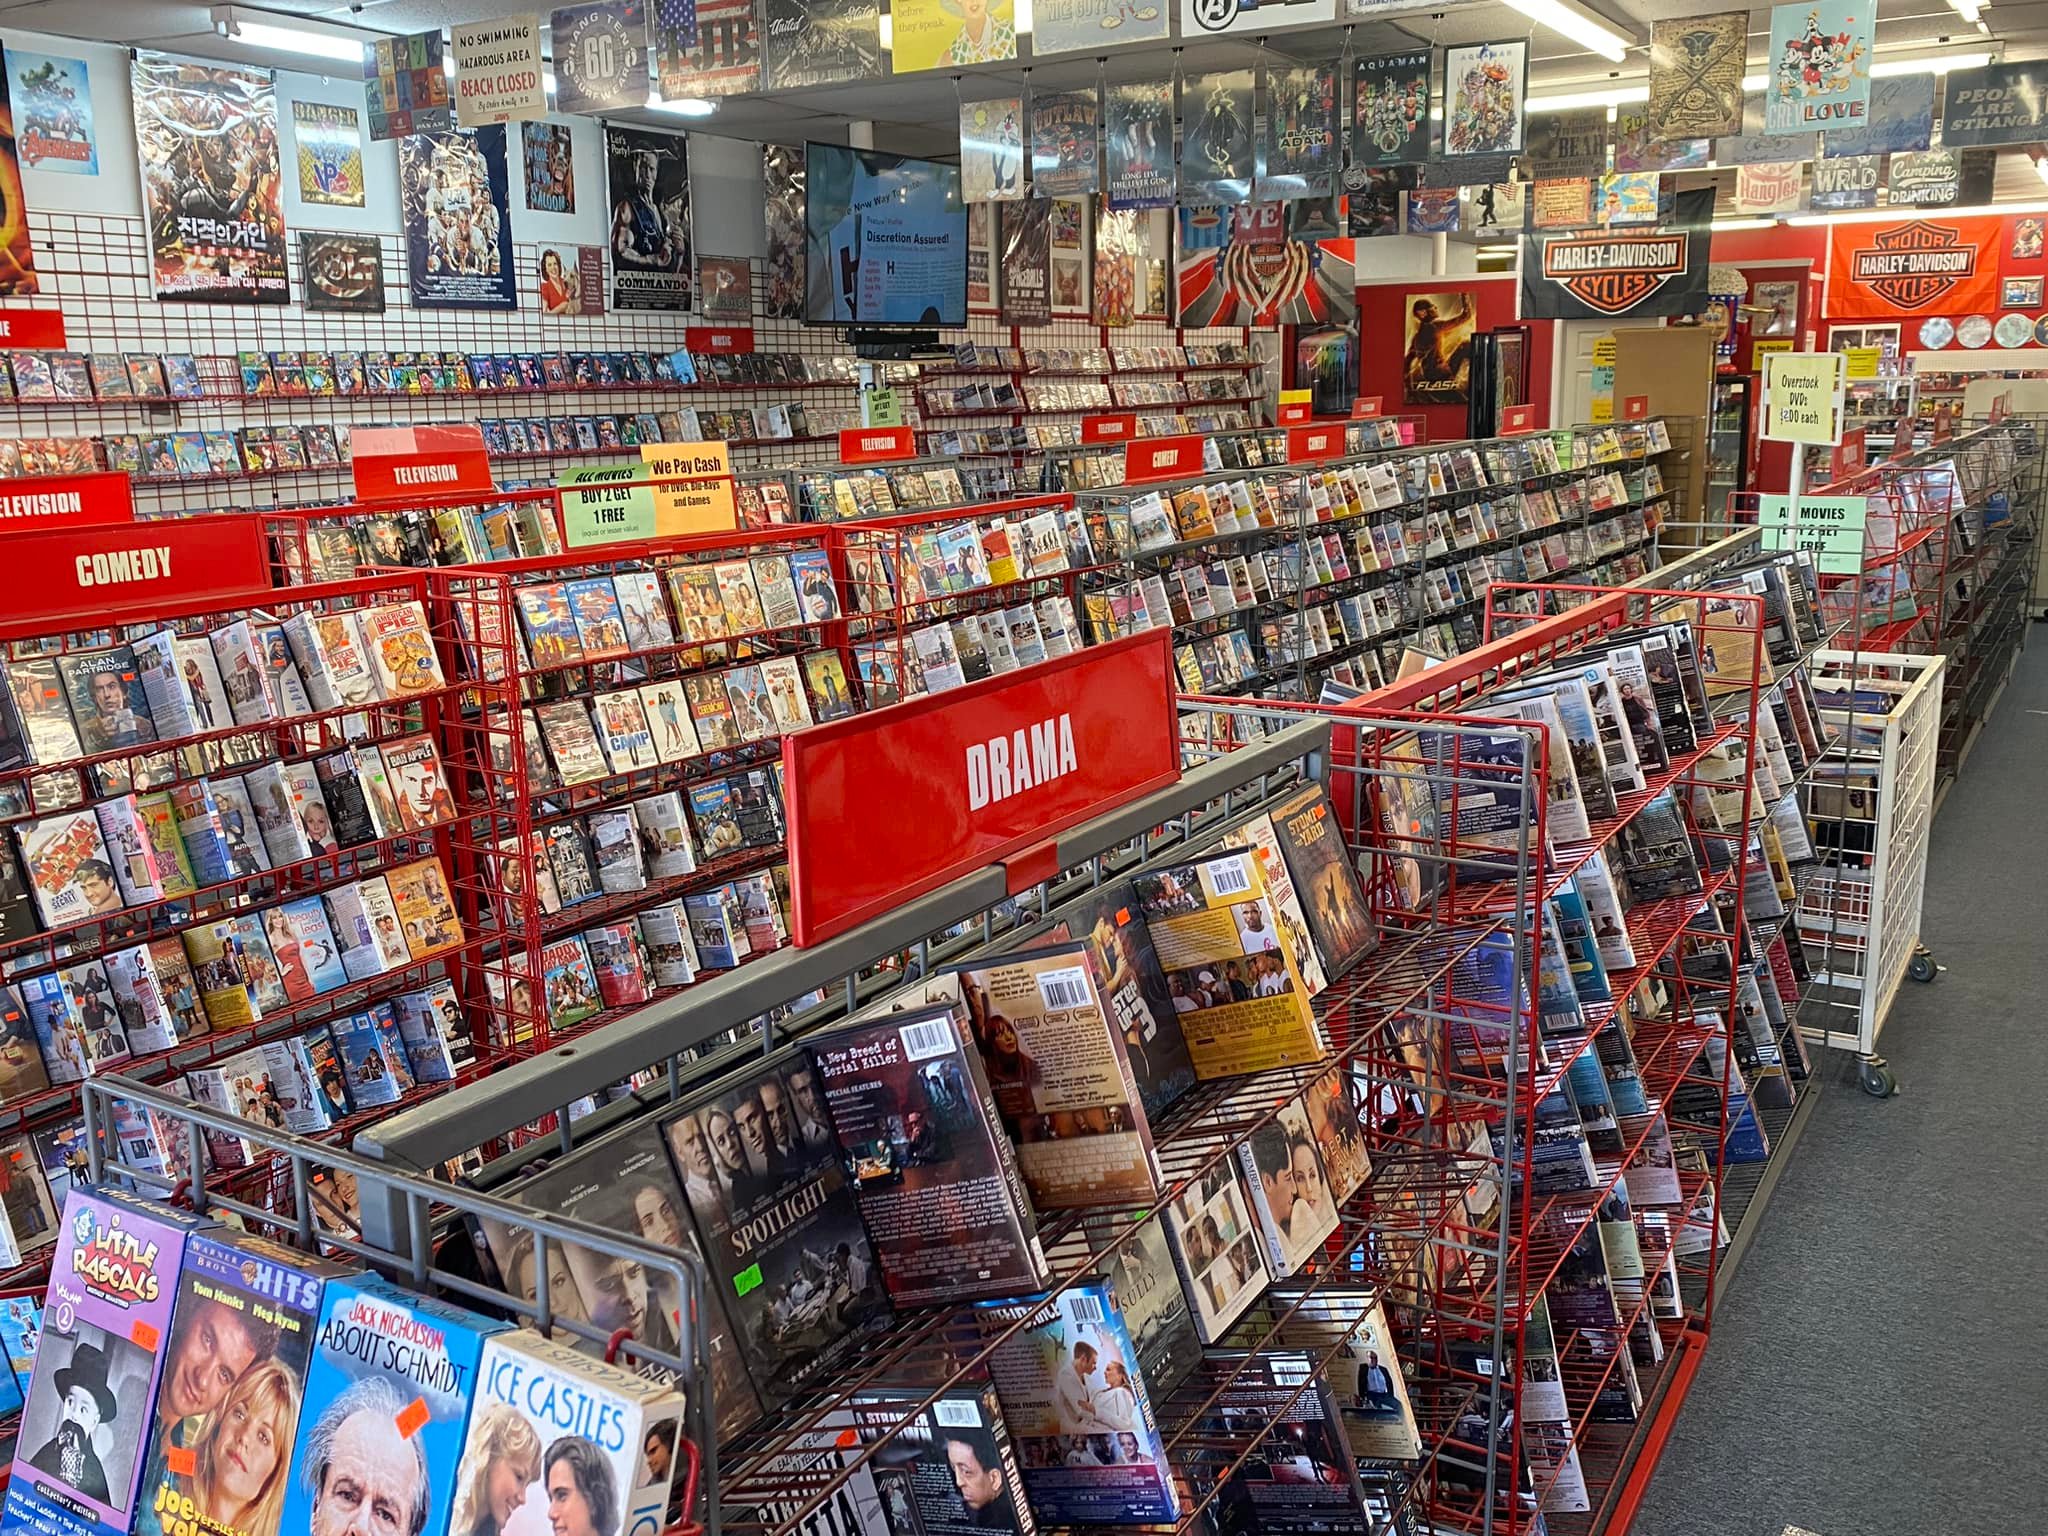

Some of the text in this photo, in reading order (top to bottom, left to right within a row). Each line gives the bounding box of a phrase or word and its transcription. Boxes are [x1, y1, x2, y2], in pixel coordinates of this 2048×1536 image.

[568, 12, 630, 55] HANG TEN
[769, 14, 804, 37] United
[898, 21, 918, 33] they
[459, 26, 529, 48] NO SWIMMING
[459, 49, 531, 70] HAZARDOUS AREA
[584, 34, 614, 80] 60
[1358, 55, 1427, 71] AQUAMAN
[461, 72, 536, 97] BEACH CLOSED
[1034, 104, 1097, 130] OUTLAW
[1804, 100, 1865, 122] LOVE
[1971, 103, 2015, 117] ARE
[1280, 135, 1328, 150] ADAM
[1288, 128, 1323, 139] BLACK
[18, 130, 92, 167] AVENGERS
[1121, 170, 1159, 181] LONG LIVE
[1816, 167, 1877, 193] WRLD
[1893, 161, 1957, 181] Camping
[1113, 179, 1126, 188] THE
[1149, 176, 1168, 186] GUN
[874, 193, 890, 204] Way
[1113, 186, 1172, 200] BRANDON
[1890, 187, 1956, 204] DRINKING
[867, 230, 949, 245] Discretion Assured!
[1888, 231, 1945, 249] MOTOR
[1554, 242, 1678, 270] HARLEY-DAVIDSON
[1861, 253, 1968, 275] HARLEY-DAVIDSON
[887, 261, 895, 275] H
[617, 277, 689, 290] COMMANDO
[1581, 274, 1646, 302] CYCLES
[1884, 279, 1941, 301] CYCLES
[1416, 380, 1461, 391] FLASH
[1782, 375, 1819, 389] Overstock
[1789, 393, 1808, 406] DVDs
[1801, 412, 1819, 425] each
[861, 436, 896, 452] TELEVISION
[394, 463, 459, 486] TELEVISION
[575, 468, 636, 483] ALL MOVIES
[653, 457, 721, 476] We Pay Cash
[581, 487, 632, 504] BUY 2 GET
[673, 495, 711, 508] and Games
[594, 508, 625, 524] 1 FREE
[1800, 508, 1845, 520] MOVIES
[76, 546, 171, 588] COMEDY
[375, 608, 414, 624] AMERICAN
[378, 616, 418, 633] PIE
[68, 661, 130, 677] PARTRIDGE
[80, 656, 115, 669] ALAN
[610, 732, 649, 752] CAMP
[407, 745, 432, 763] APPLE
[965, 712, 1078, 812] DRAMA
[550, 824, 573, 838] Clue
[1301, 822, 1326, 847] YARD
[1111, 984, 1139, 1014] STEP
[1118, 1011, 1136, 1032] UP
[816, 1038, 898, 1067] A New Breed of
[823, 1053, 898, 1078] Serial Killer
[825, 1080, 883, 1099] SPECIAL FEATURES
[1240, 1142, 1261, 1192] OVEMBER
[731, 1177, 828, 1257] SPOTLIGHT
[192, 1240, 238, 1265] WARNER
[72, 1249, 159, 1302] RASCALS
[253, 1263, 319, 1311] HITS
[1120, 1271, 1157, 1314] SULLY
[193, 1281, 301, 1332] Tom Hanks Meg Ryan
[60, 1309, 69, 1327] 2
[348, 1300, 378, 1328] JACK
[379, 1309, 445, 1351] NICHOLSON
[320, 1318, 382, 1364] ABOUT
[487, 1356, 625, 1452] ICE CASTLES
[855, 1412, 864, 1424] A
[1000, 1446, 1035, 1534] A STRANGER
[154, 1481, 194, 1521] joe
